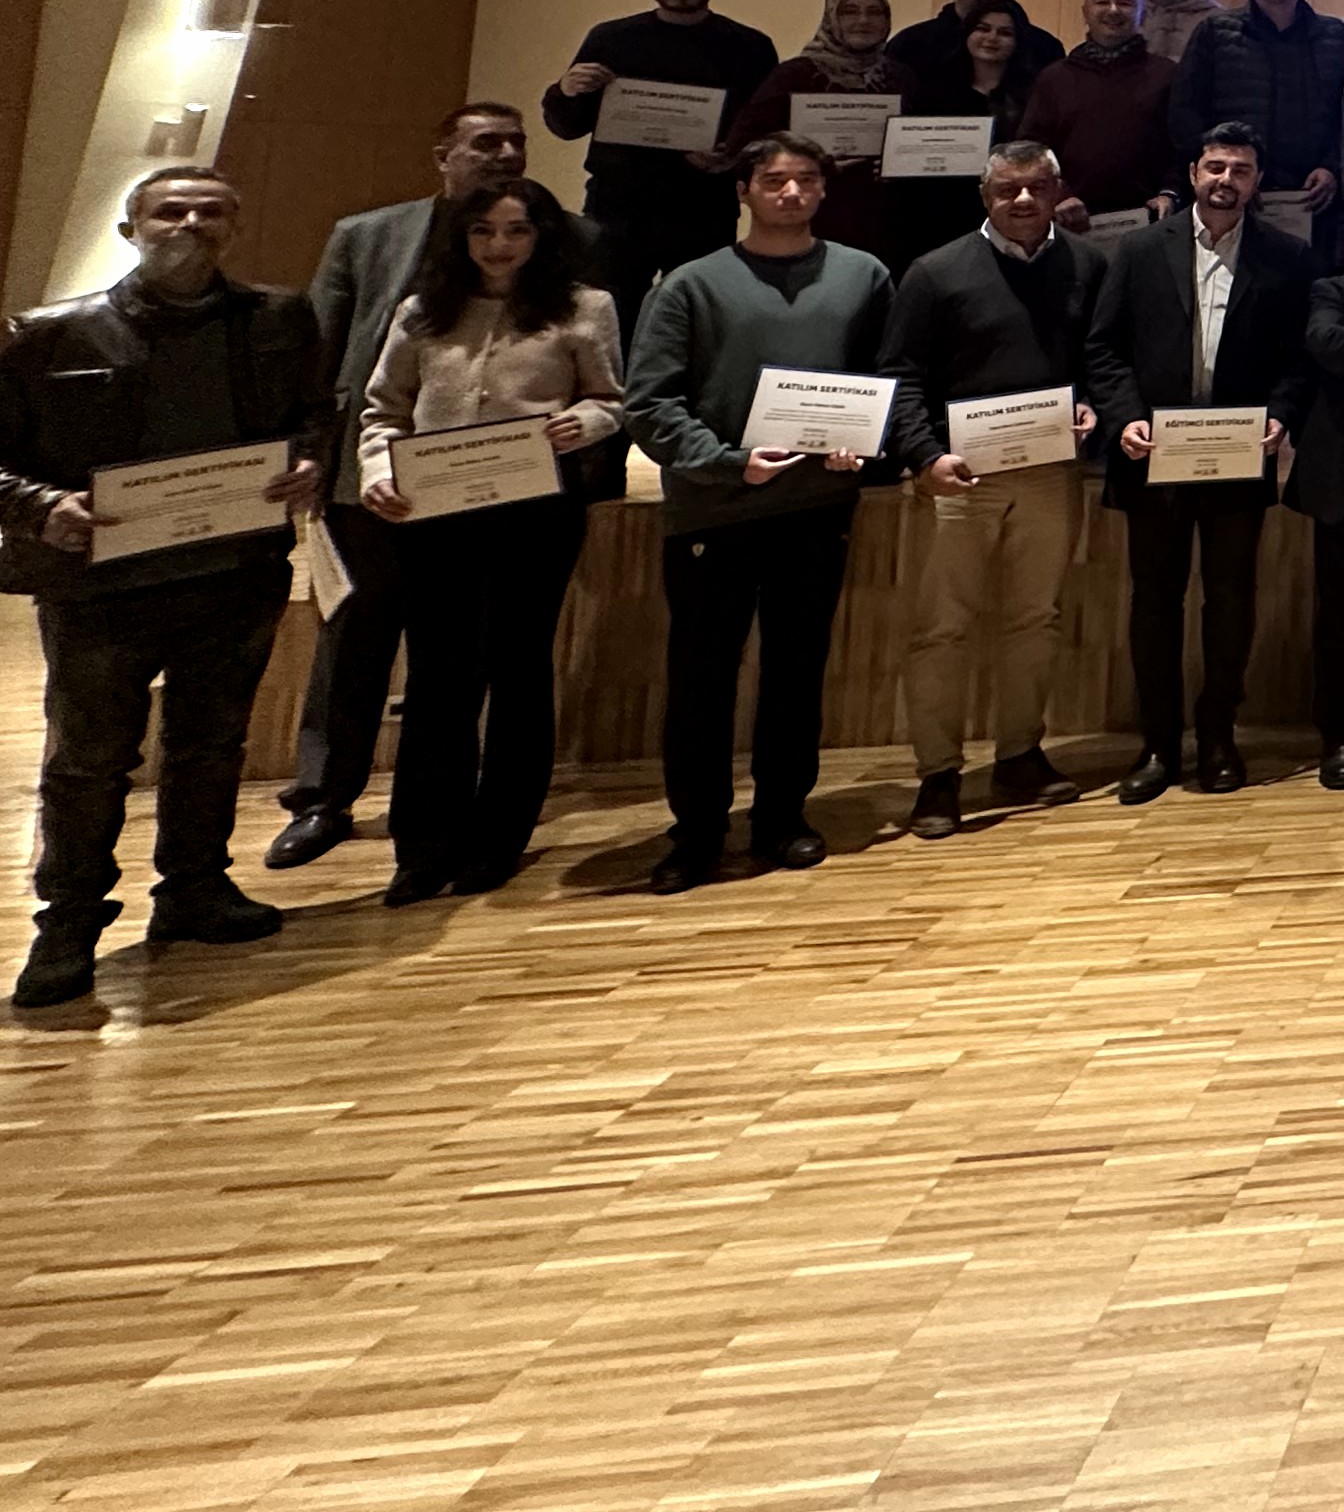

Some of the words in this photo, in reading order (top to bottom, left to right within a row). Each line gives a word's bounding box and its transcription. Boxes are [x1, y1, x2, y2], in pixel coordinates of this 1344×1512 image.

[776, 382, 818, 392] KATILIM
[819, 384, 878, 396] SERTİFİKASI
[966, 408, 1004, 419] KATILIM
